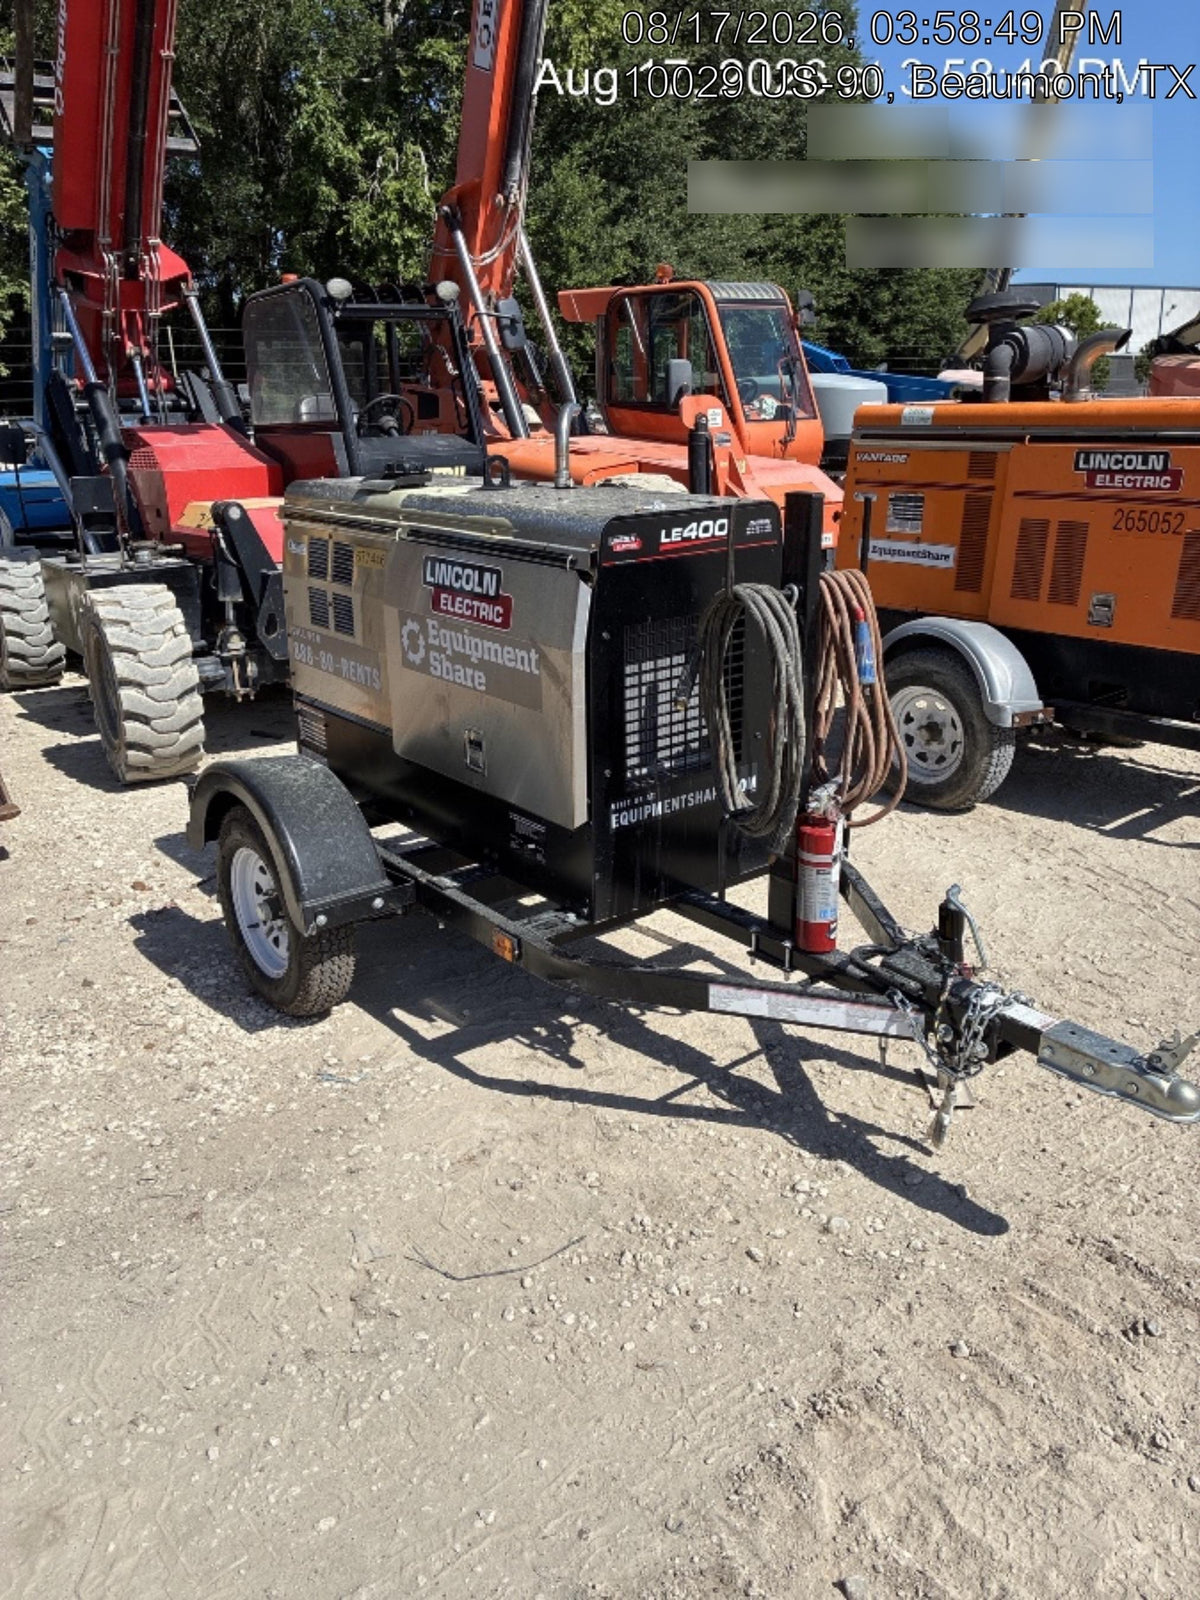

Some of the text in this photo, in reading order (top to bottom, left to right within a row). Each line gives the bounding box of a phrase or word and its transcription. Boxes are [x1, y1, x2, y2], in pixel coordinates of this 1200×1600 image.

[856, 452, 909, 464] VANTAGE
[1078, 453, 1164, 470] LINCOLN
[1095, 474, 1172, 488] ELECTRIC
[660, 519, 728, 543] LE400
[1112, 508, 1185, 535] 265052
[425, 560, 498, 596] LINCOLN
[439, 593, 504, 623] ELECTRIC
[426, 618, 540, 675] Equipment
[429, 652, 487, 691] Share
